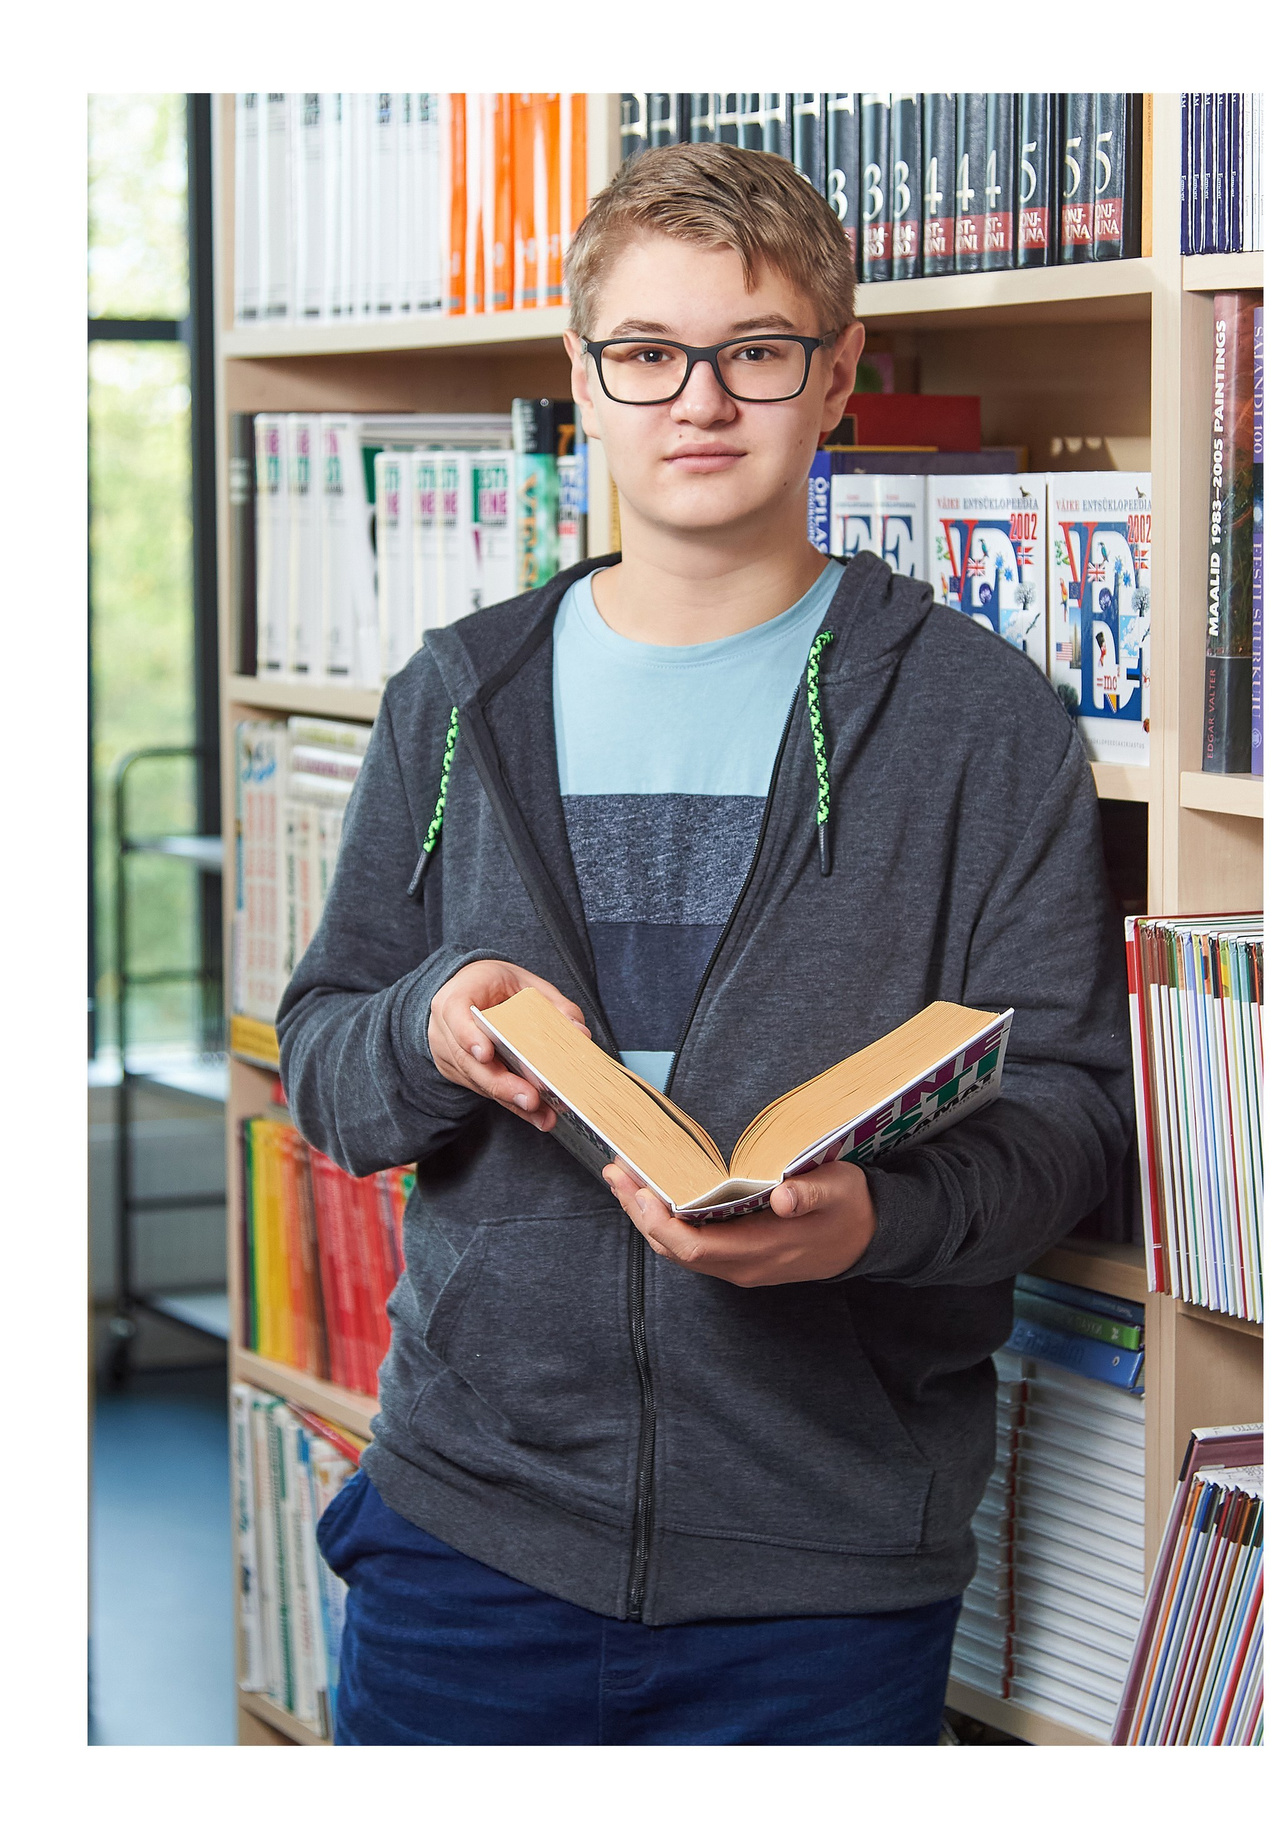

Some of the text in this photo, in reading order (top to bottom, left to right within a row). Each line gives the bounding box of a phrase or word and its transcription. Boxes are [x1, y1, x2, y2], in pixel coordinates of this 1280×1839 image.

[895, 160, 911, 218] 3
[925, 156, 943, 214] 4
[956, 153, 975, 211] 4
[985, 150, 1001, 208] 4
[1020, 141, 1037, 203] 5
[1063, 136, 1082, 198] 5
[1095, 130, 1113, 195] 5
[863, 163, 883, 221] 3
[1213, 319, 1226, 433] PAINTINGS
[937, 496, 1039, 511] VÄIKE ENTSÜKLOPEEDIA
[1009, 513, 1038, 541] 2002
[1055, 498, 1080, 512] VÄIKE
[1127, 514, 1151, 543] 2002
[1208, 552, 1221, 637] MAALID
[1206, 669, 1217, 760] EDGAR VALTER
